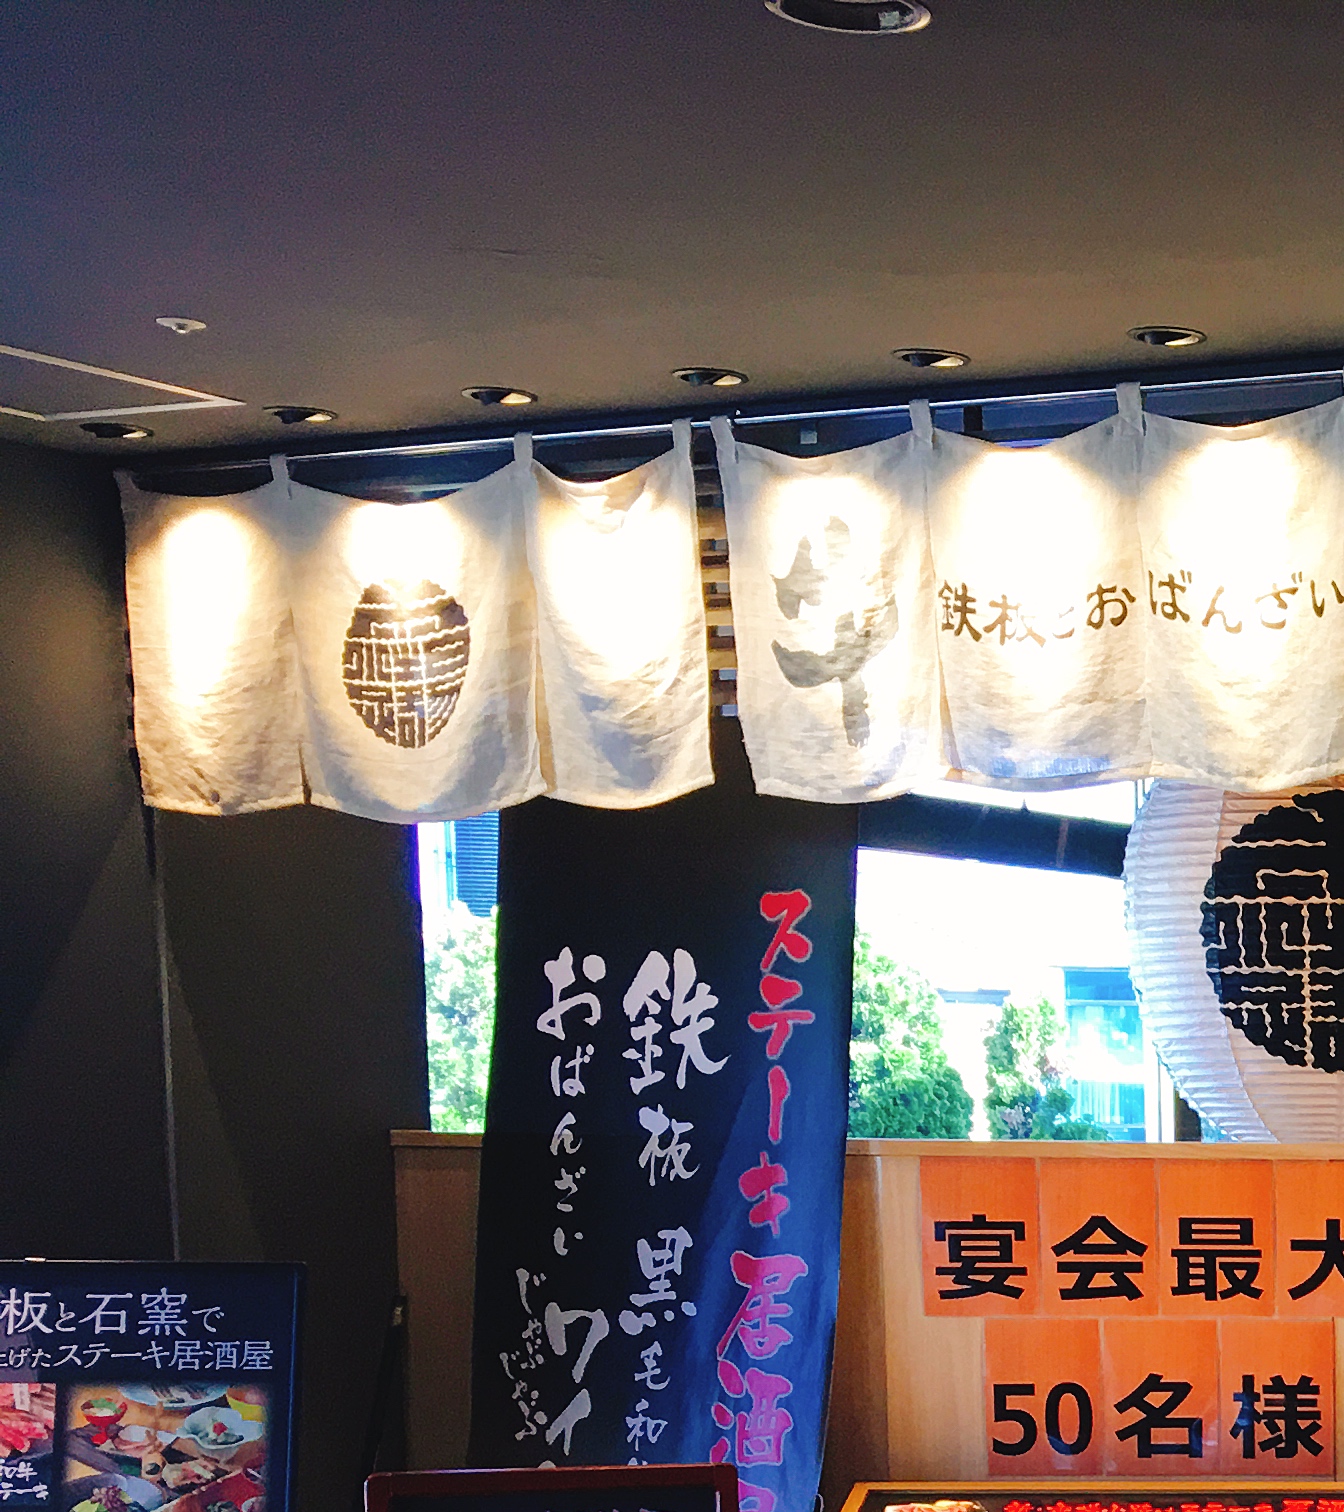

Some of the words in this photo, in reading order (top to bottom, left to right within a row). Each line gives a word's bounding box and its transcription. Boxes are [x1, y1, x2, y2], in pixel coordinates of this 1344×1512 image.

[618, 948, 732, 1466] 鉄板黒毛和
[0, 1287, 225, 1337] 板と石窯で
[991, 1372, 1324, 1461] 50名様
